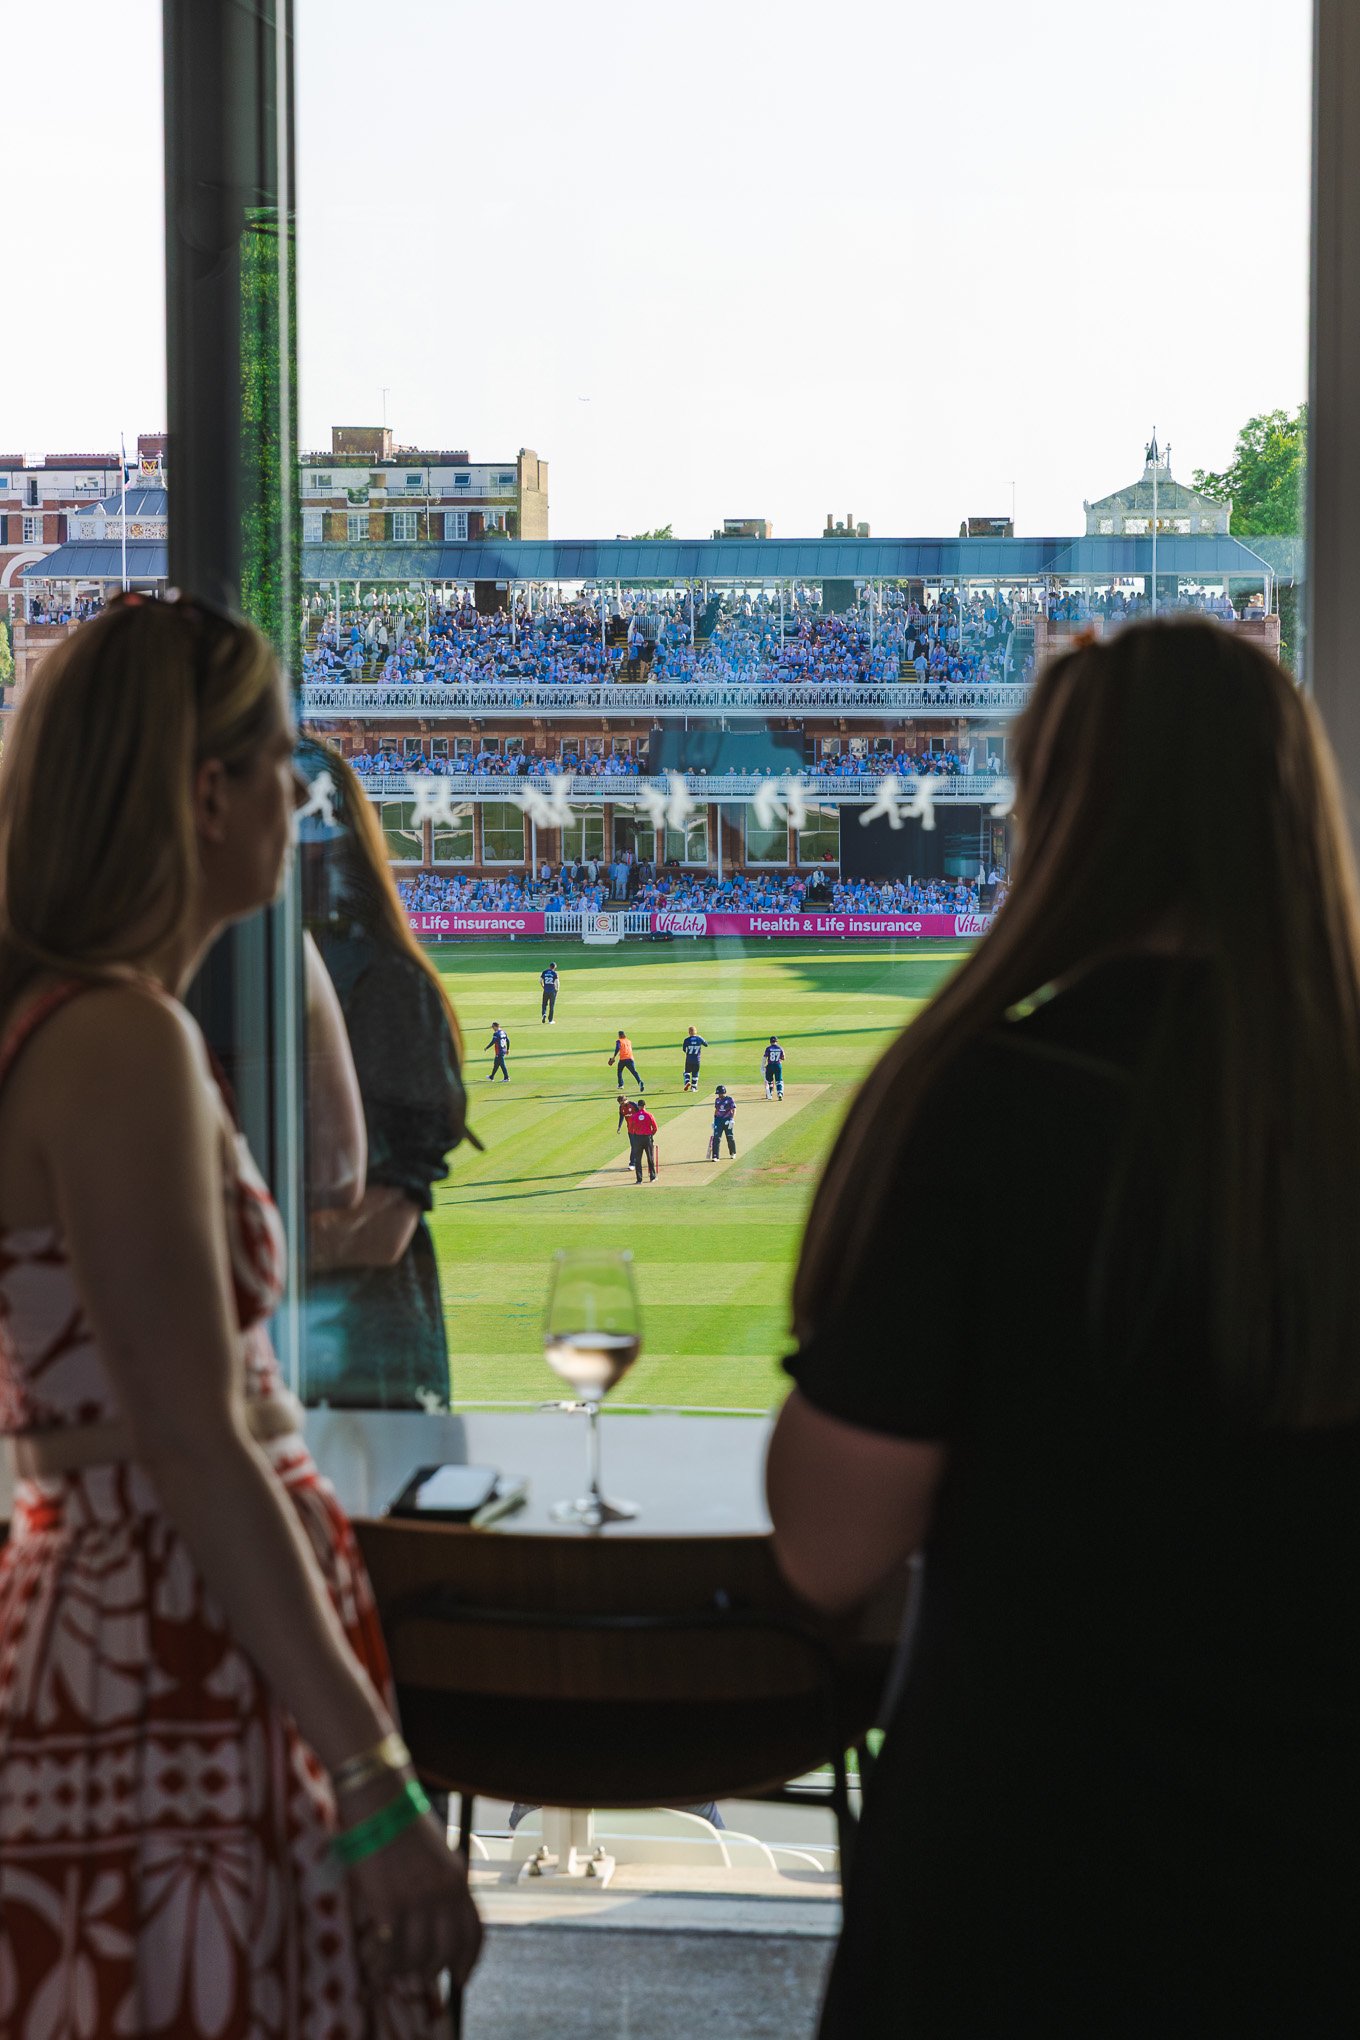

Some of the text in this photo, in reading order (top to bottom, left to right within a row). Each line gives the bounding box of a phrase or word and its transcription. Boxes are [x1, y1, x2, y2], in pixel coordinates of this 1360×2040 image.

[422, 915, 450, 929] Life
[453, 916, 526, 929] insurance
[659, 913, 705, 935] Vitality
[749, 917, 922, 931] Health & Life insurance
[688, 1045, 700, 1054] 77
[770, 1051, 781, 1061] 87
